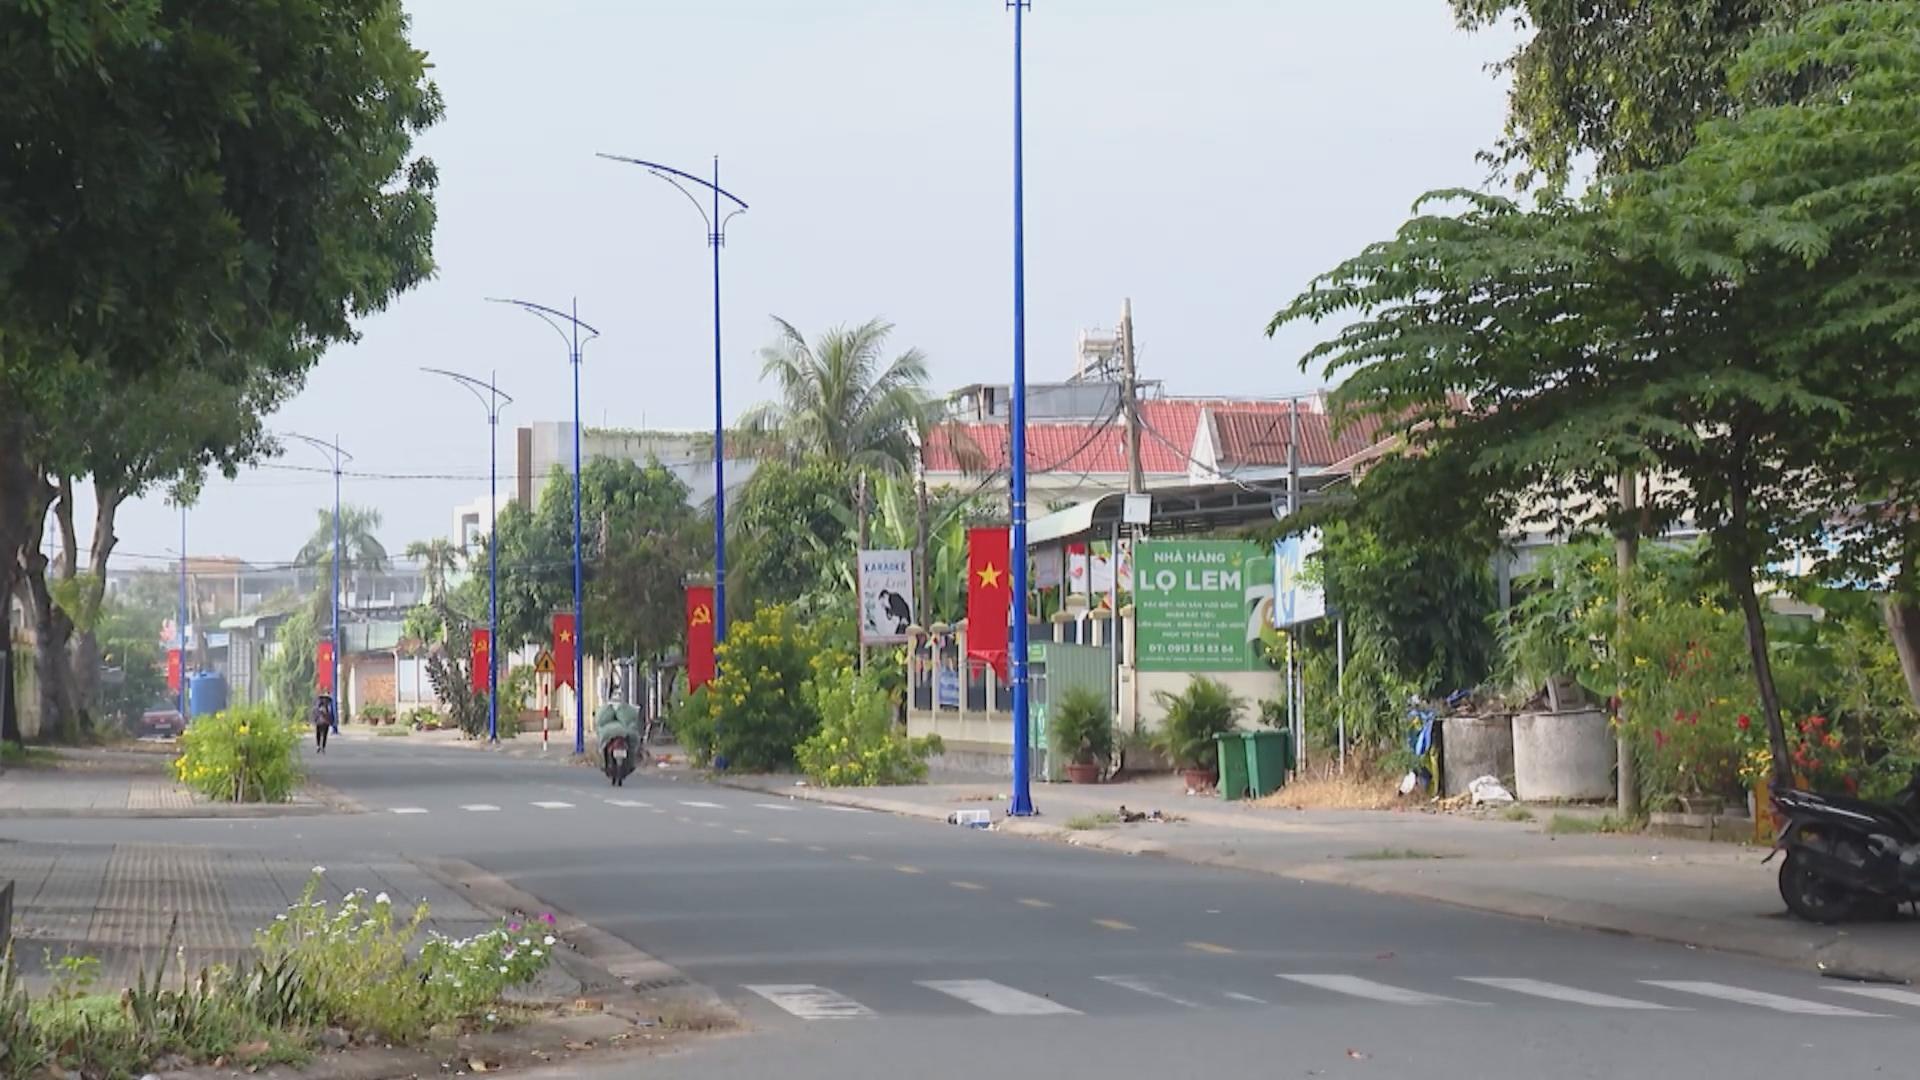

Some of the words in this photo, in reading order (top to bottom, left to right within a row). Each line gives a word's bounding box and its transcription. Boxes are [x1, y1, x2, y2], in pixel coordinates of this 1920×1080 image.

[1154, 549, 1183, 563] NHÀ
[1187, 549, 1225, 563] HÀNG
[865, 562, 906, 573] KARAOKE
[1140, 570, 1177, 595] LỌ
[1186, 570, 1241, 591] LEM
[1168, 644, 1190, 653] 0913
